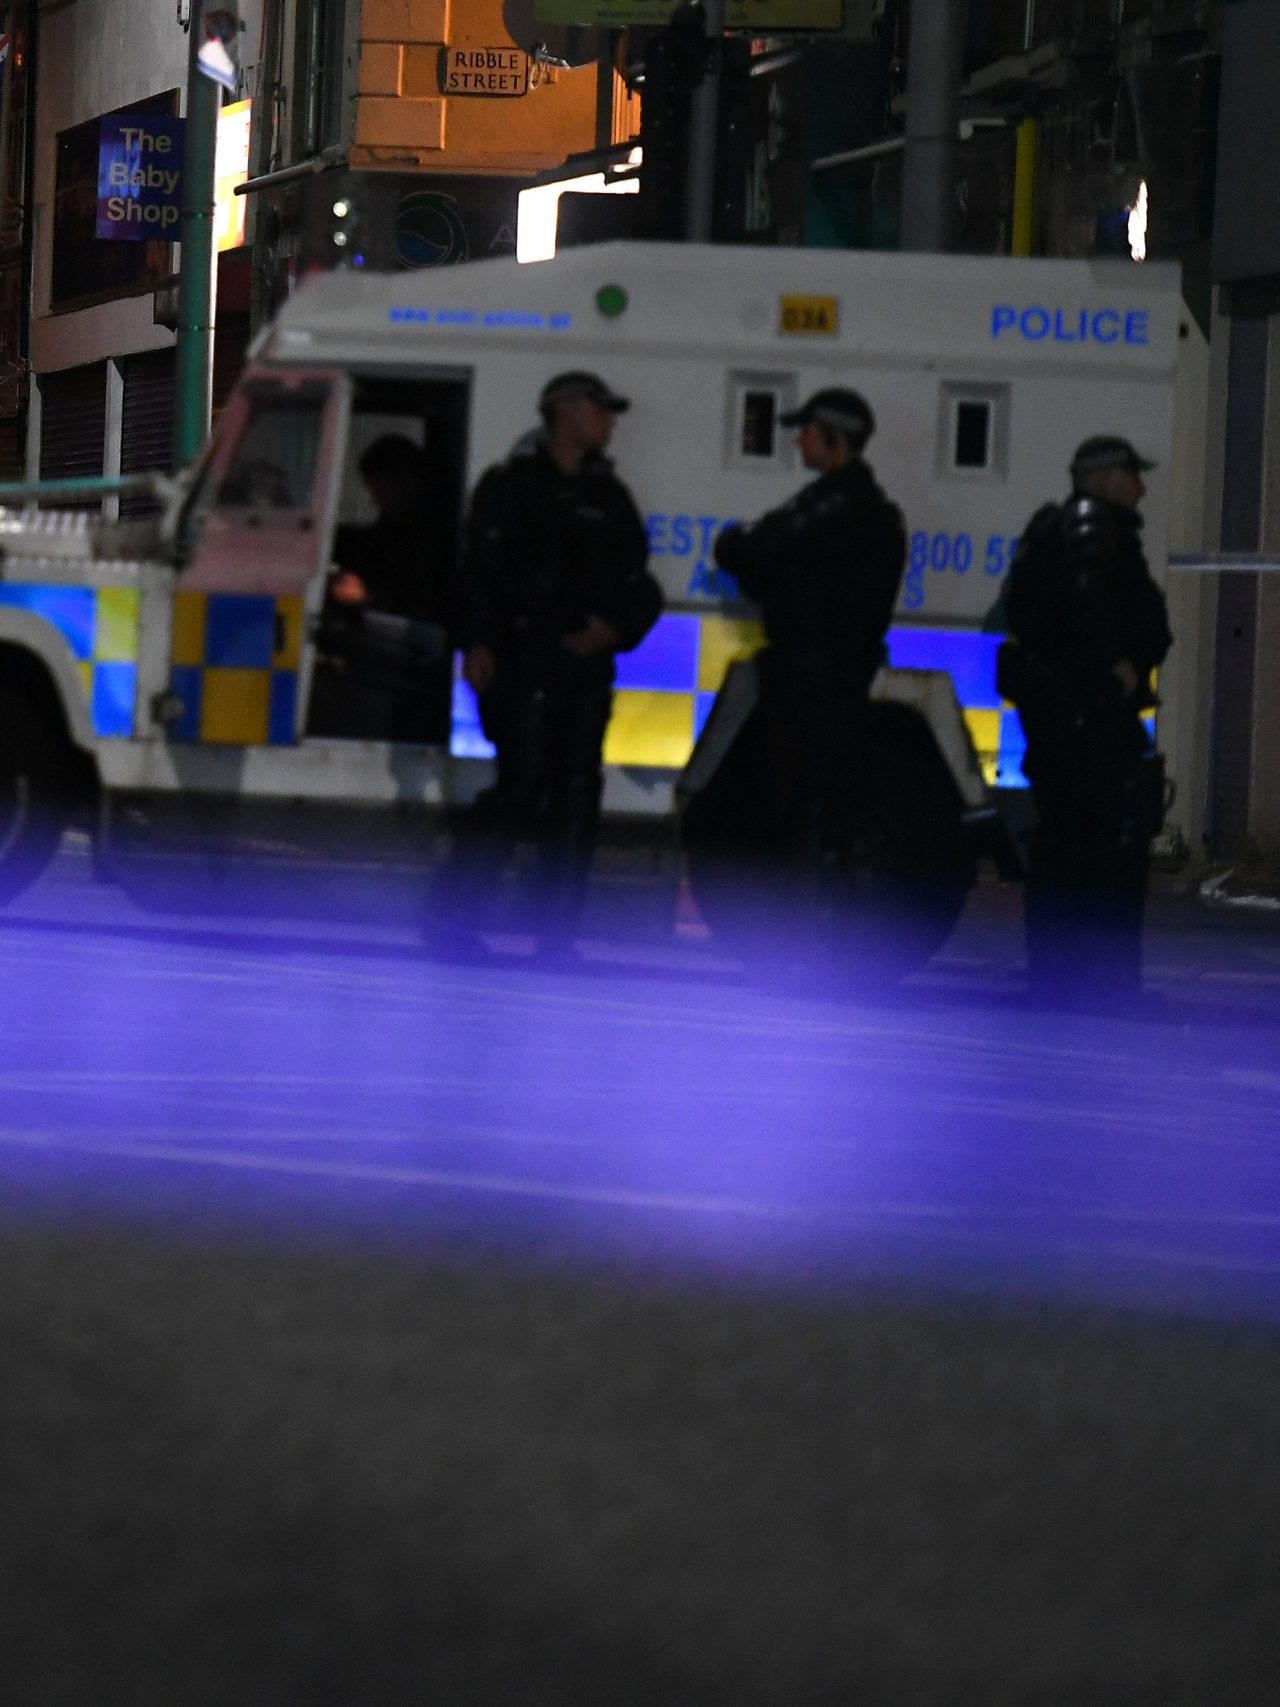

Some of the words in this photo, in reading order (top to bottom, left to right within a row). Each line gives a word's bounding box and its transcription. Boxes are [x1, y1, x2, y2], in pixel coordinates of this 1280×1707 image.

[456, 52, 518, 69] RIBBLE
[450, 73, 522, 89] STREET
[119, 127, 172, 152] The
[110, 161, 180, 194] Baby
[107, 197, 180, 229] Shop
[991, 304, 1150, 345] POLICE
